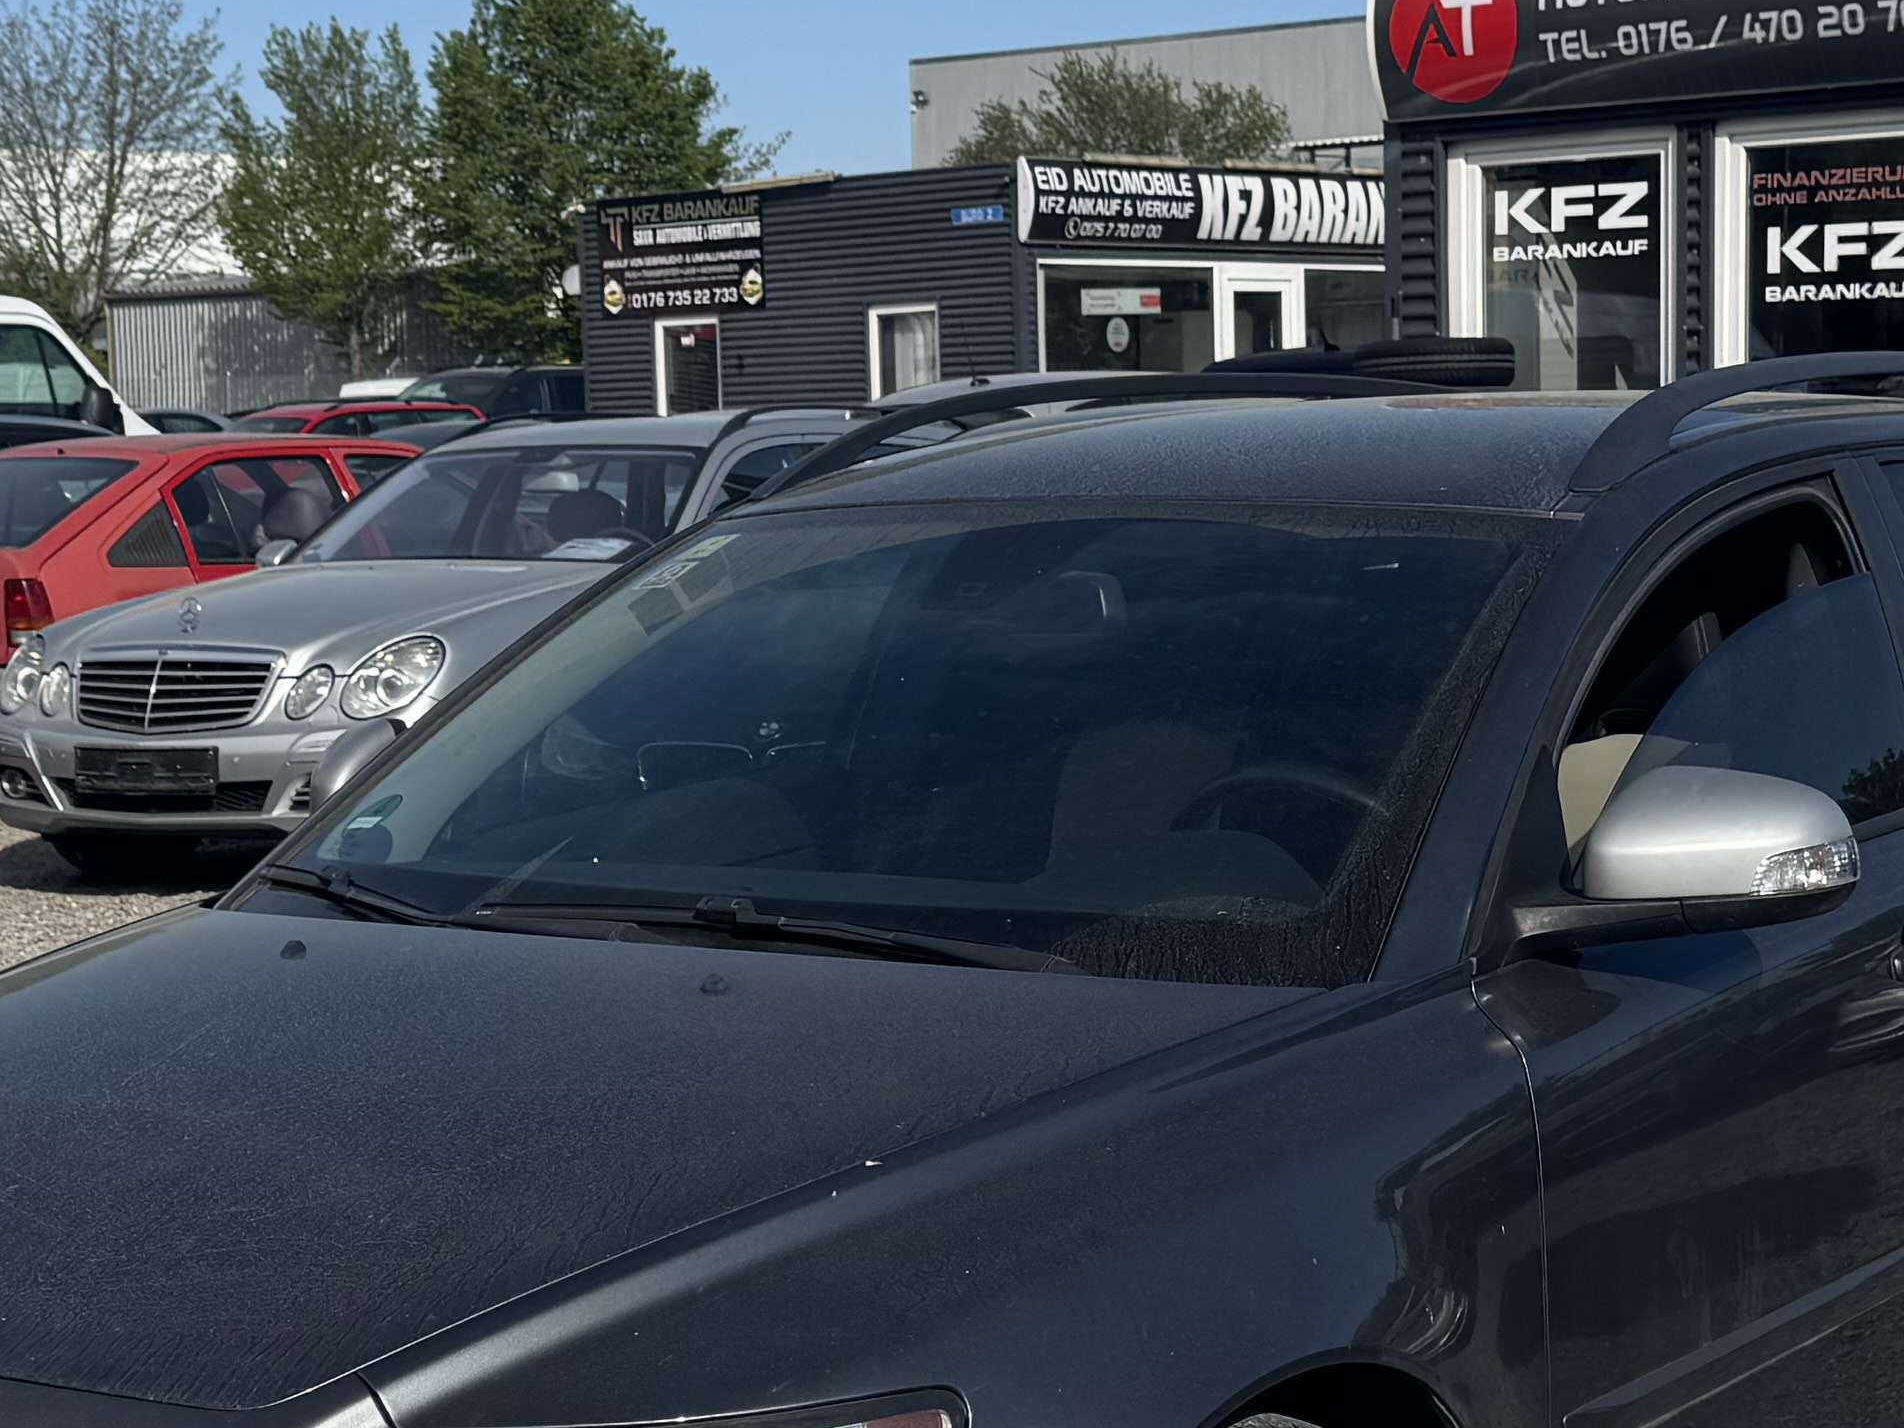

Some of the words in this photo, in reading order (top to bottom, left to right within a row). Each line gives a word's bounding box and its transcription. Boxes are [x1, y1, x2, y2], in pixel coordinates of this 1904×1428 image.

[1539, 30, 1608, 63] TEL.
[1617, 19, 1694, 57] 0176
[1742, 8, 1804, 44] 470
[1817, 2, 1865, 39] 20
[1034, 166, 1069, 192] EID
[1073, 168, 1195, 198] AUTOMOBILE
[631, 204, 660, 223] KFZ
[663, 195, 761, 221] BARANKAUF
[1038, 195, 1064, 214] KFZ
[1067, 197, 1121, 218] ANKAUF
[1136, 200, 1195, 220] VERKAUF
[1196, 173, 1266, 243] KFZ
[1494, 181, 1648, 235] KFZ
[1753, 191, 1808, 207] OHNE
[1493, 238, 1648, 262] BARANKAUF
[632, 291, 665, 308] 0176
[667, 289, 691, 306] 735
[693, 289, 711, 305] 22
[713, 287, 738, 303] 733
